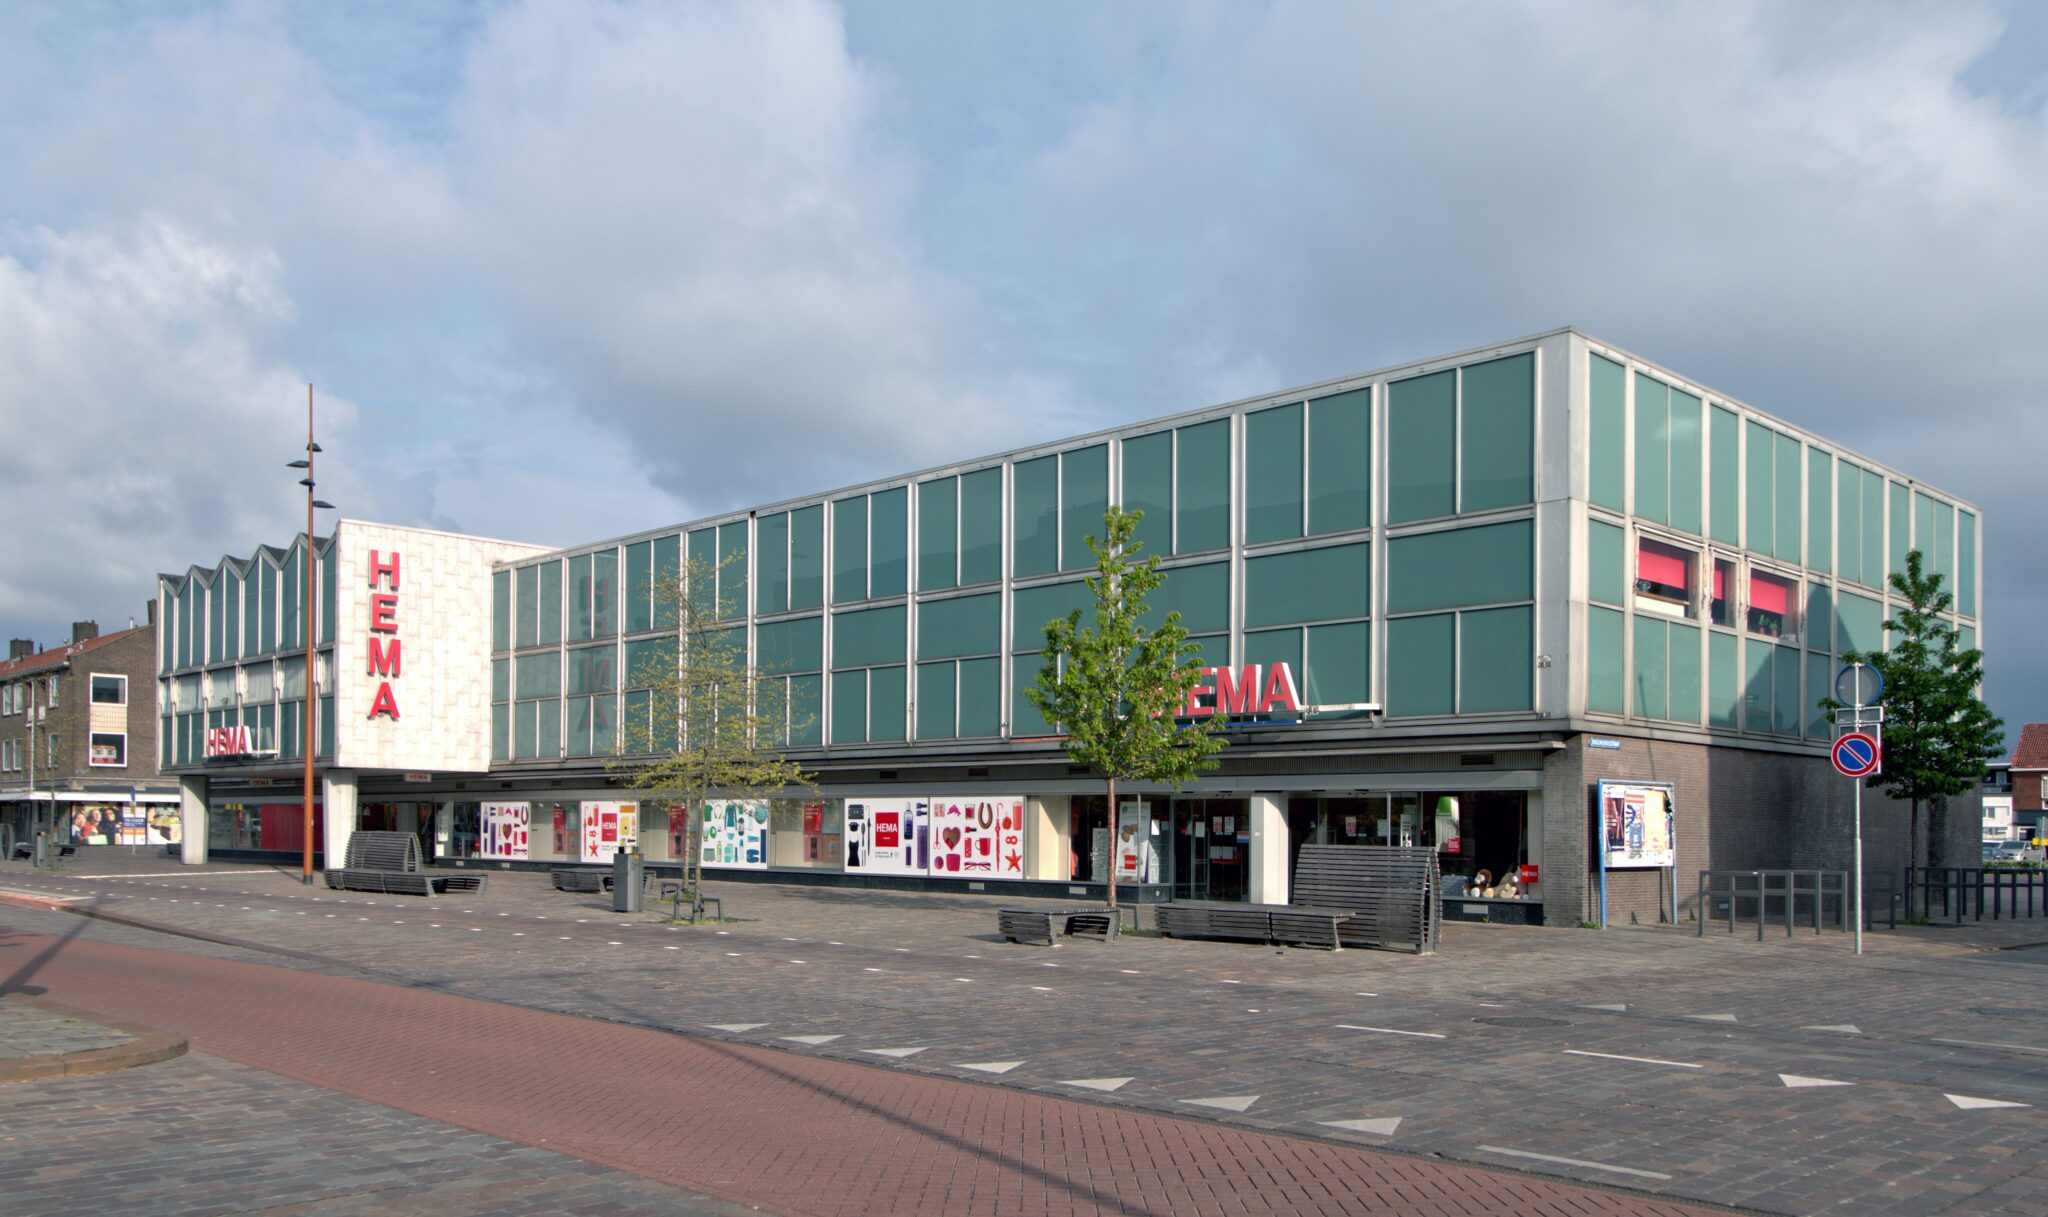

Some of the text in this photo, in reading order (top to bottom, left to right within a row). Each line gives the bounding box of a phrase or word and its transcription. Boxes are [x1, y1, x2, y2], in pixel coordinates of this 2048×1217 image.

[368, 550, 401, 719] HEMA
[207, 726, 251, 756] HEMA
[602, 821, 617, 830] HEMA
[876, 822, 898, 833] HEMA
